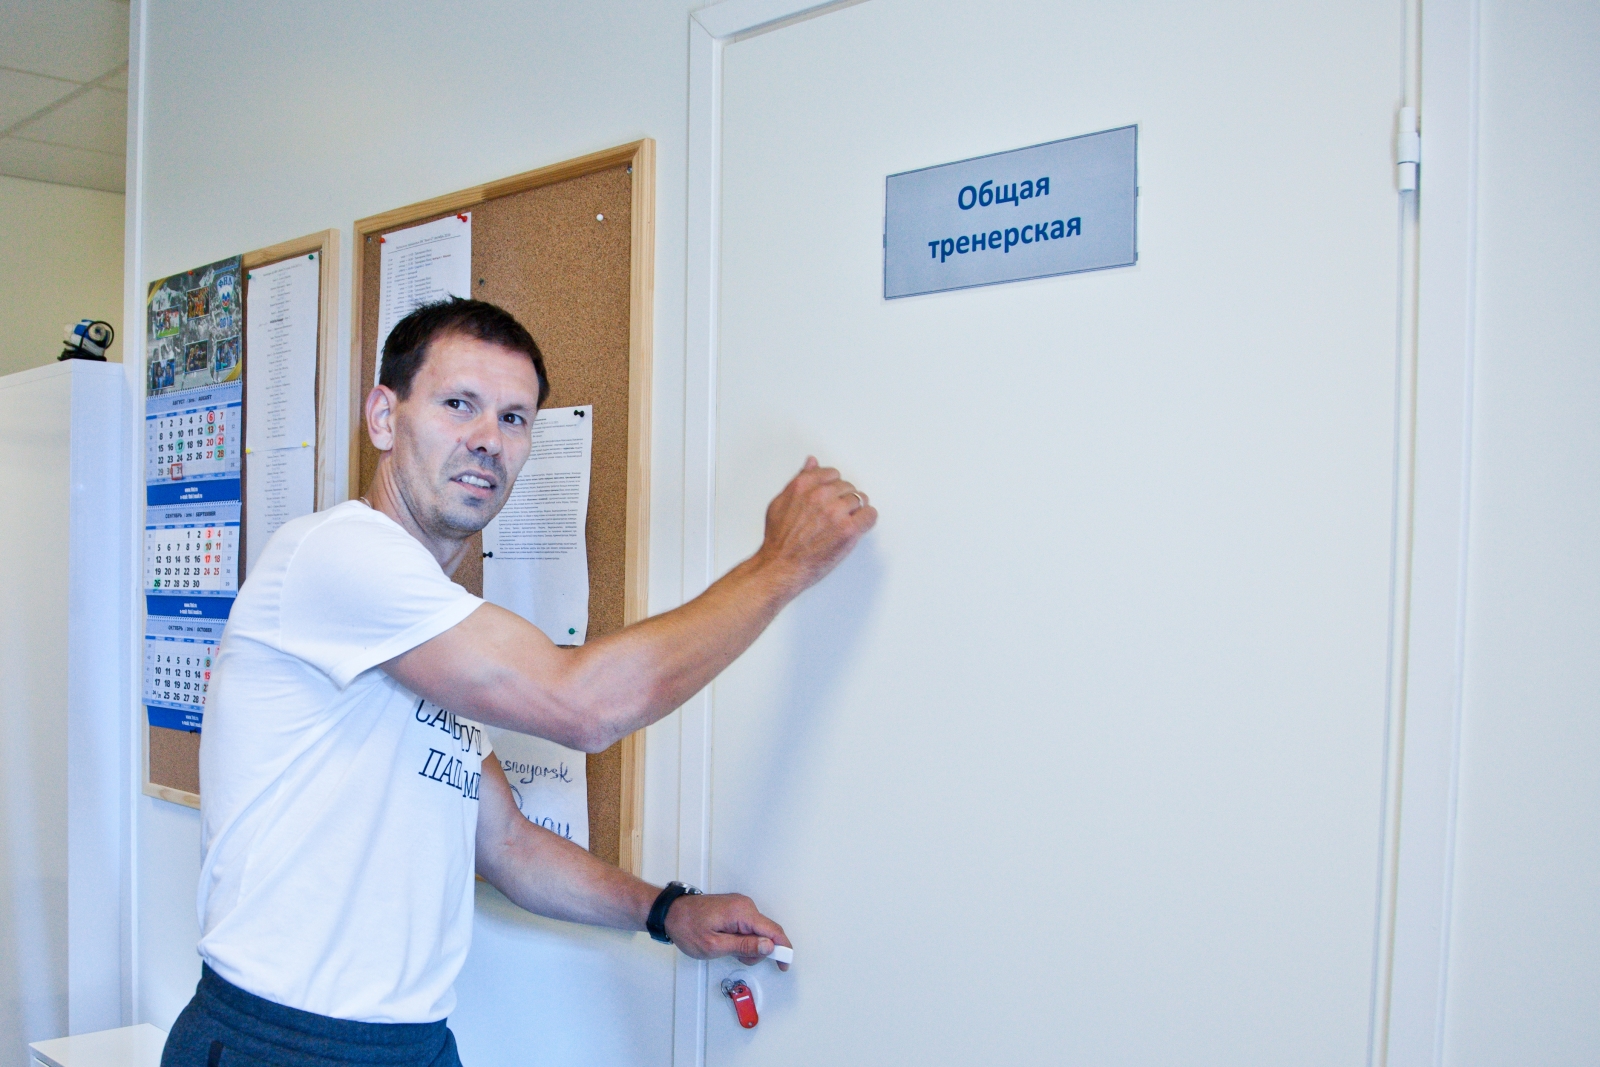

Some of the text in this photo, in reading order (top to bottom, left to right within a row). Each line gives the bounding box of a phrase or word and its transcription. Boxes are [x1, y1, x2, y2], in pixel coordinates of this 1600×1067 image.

[957, 176, 1050, 211] Общая
[928, 216, 1082, 263] тренерская
[179, 418, 183, 426] 3
[209, 413, 213, 421] 6
[178, 430, 184, 438] 10
[197, 427, 203, 435] 12
[178, 442, 183, 450] 17
[218, 437, 224, 445] 21
[167, 455, 173, 463] 23
[186, 453, 192, 461] 25
[196, 452, 202, 460] 26
[206, 451, 213, 459] 27
[207, 530, 211, 538] 3
[177, 543, 180, 551] 7
[186, 543, 190, 551] 8
[193, 580, 199, 588] 30
[207, 647, 210, 655] 1
[194, 683, 199, 691] 21
[184, 694, 189, 702] 27
[192, 695, 199, 703] 28
[499, 760, 573, 785] snoyarsk
